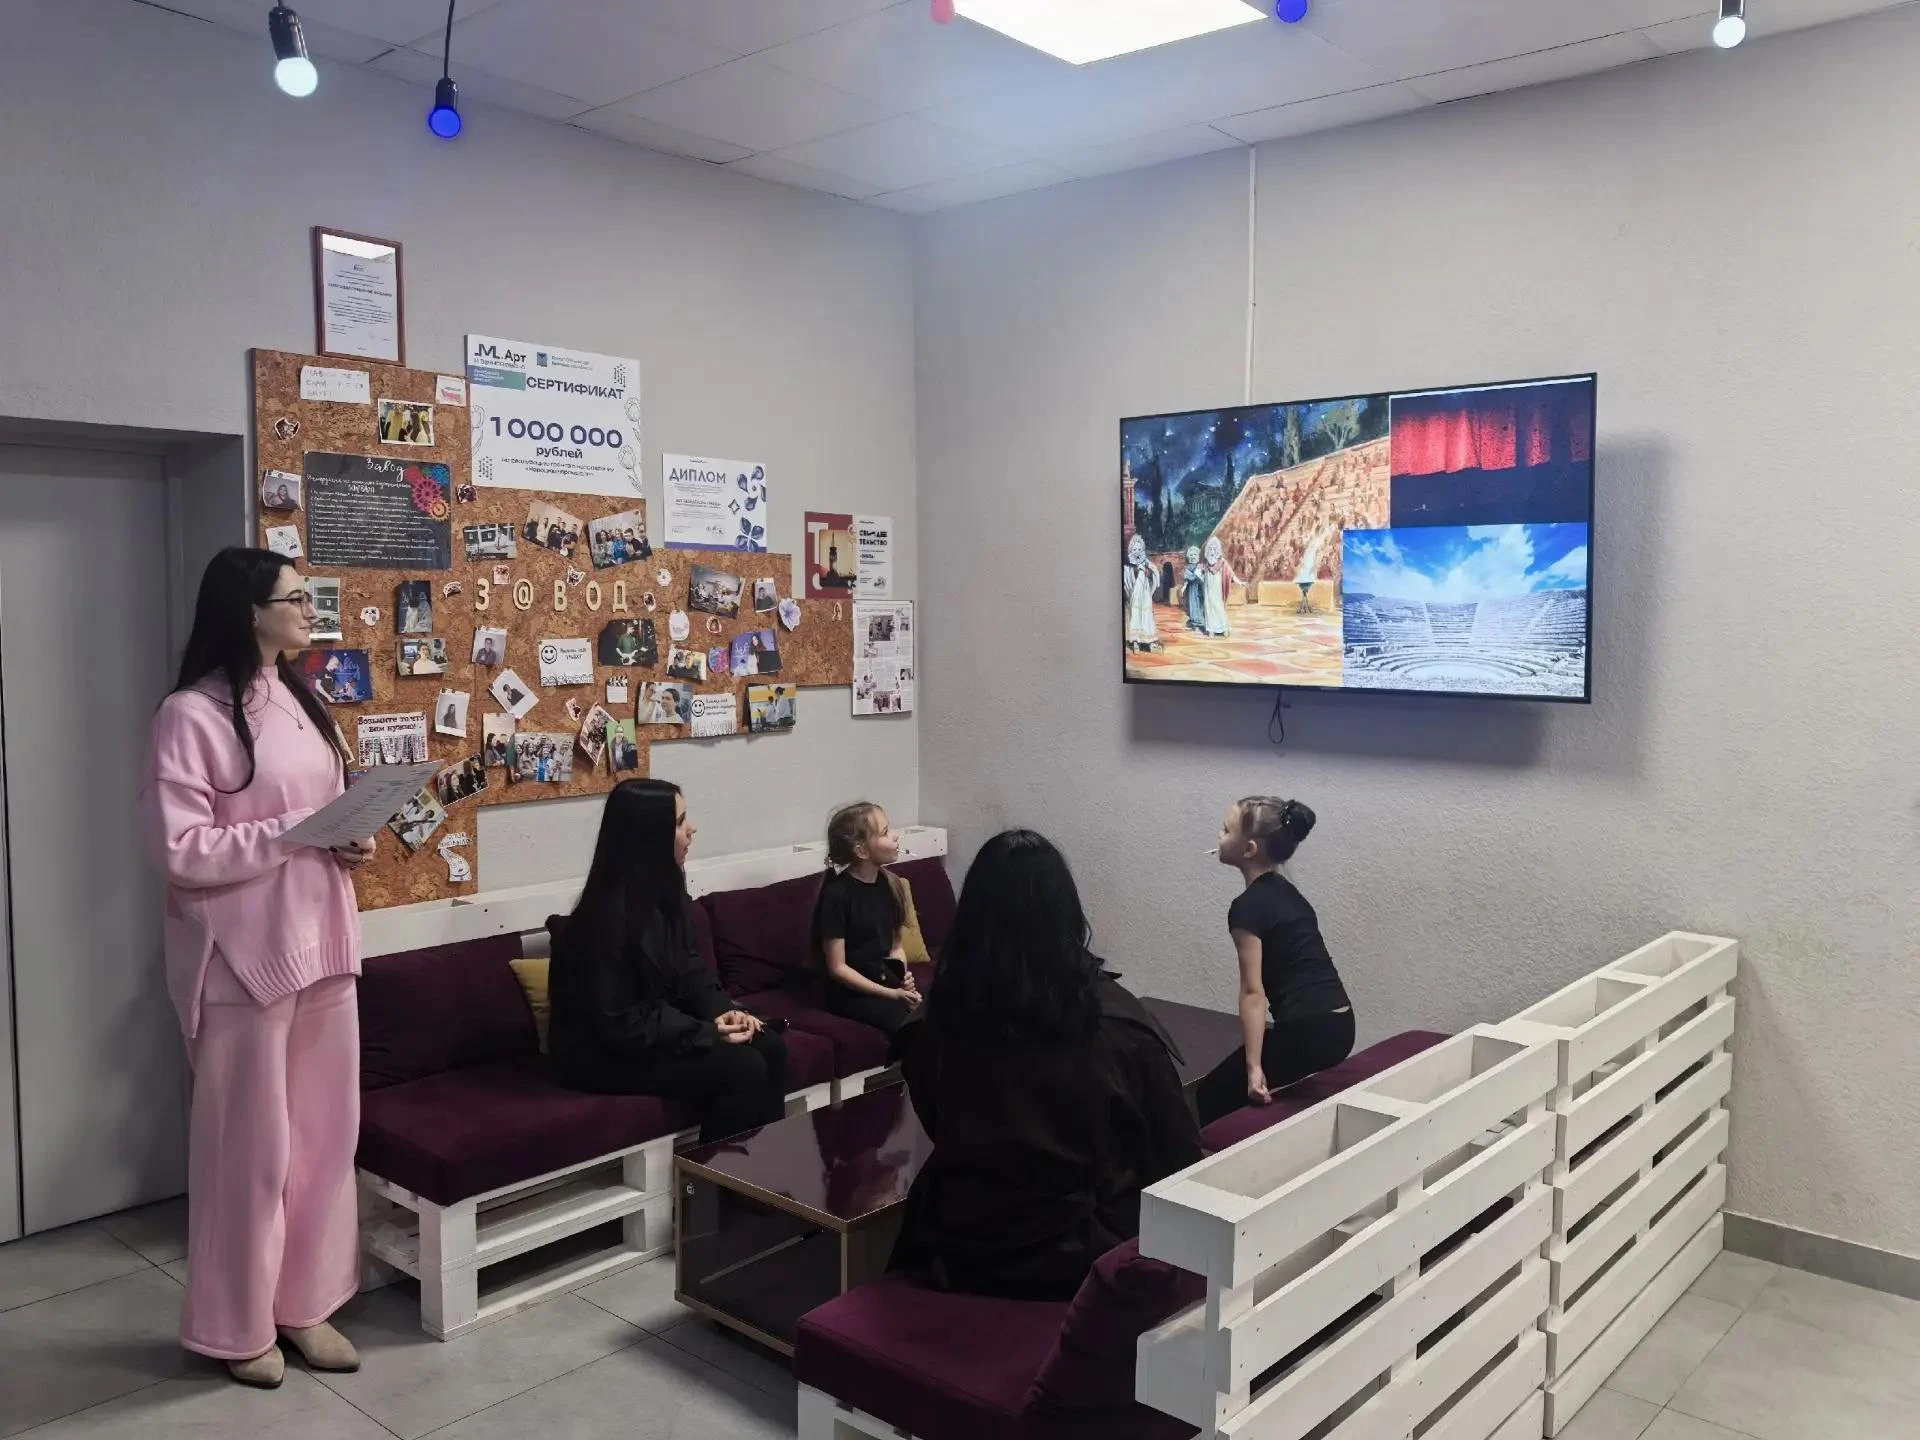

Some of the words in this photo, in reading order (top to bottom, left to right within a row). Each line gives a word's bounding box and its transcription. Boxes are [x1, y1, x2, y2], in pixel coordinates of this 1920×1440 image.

[526, 376, 624, 400] СЕРТИФИКАТ
[536, 446, 583, 459] рублей
[366, 457, 405, 482] Завод
[669, 467, 726, 484] ДИПЛОМ
[358, 716, 398, 725] Возьмите
